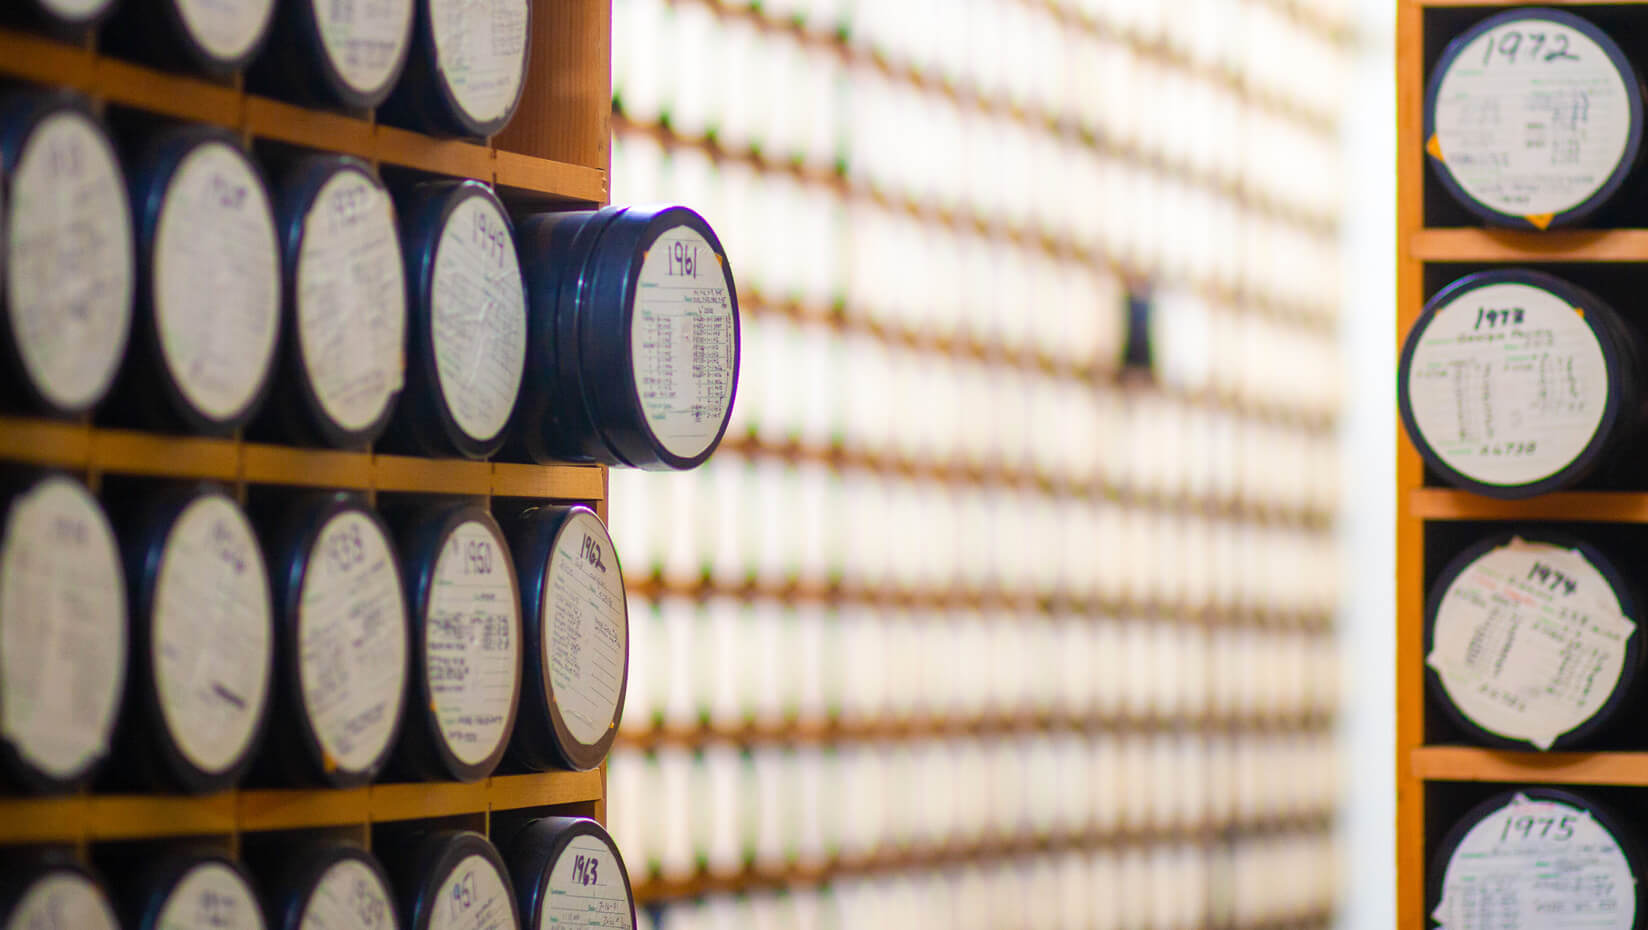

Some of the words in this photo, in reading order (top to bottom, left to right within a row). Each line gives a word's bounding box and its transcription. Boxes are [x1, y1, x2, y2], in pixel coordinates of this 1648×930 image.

[1483, 31, 1580, 67] 1972
[472, 209, 504, 268] 1949
[668, 240, 697, 279] 1961
[464, 540, 492, 574] 1950
[580, 532, 606, 573] 1962
[1501, 815, 1577, 842] 1975
[572, 854, 599, 887] 1963
